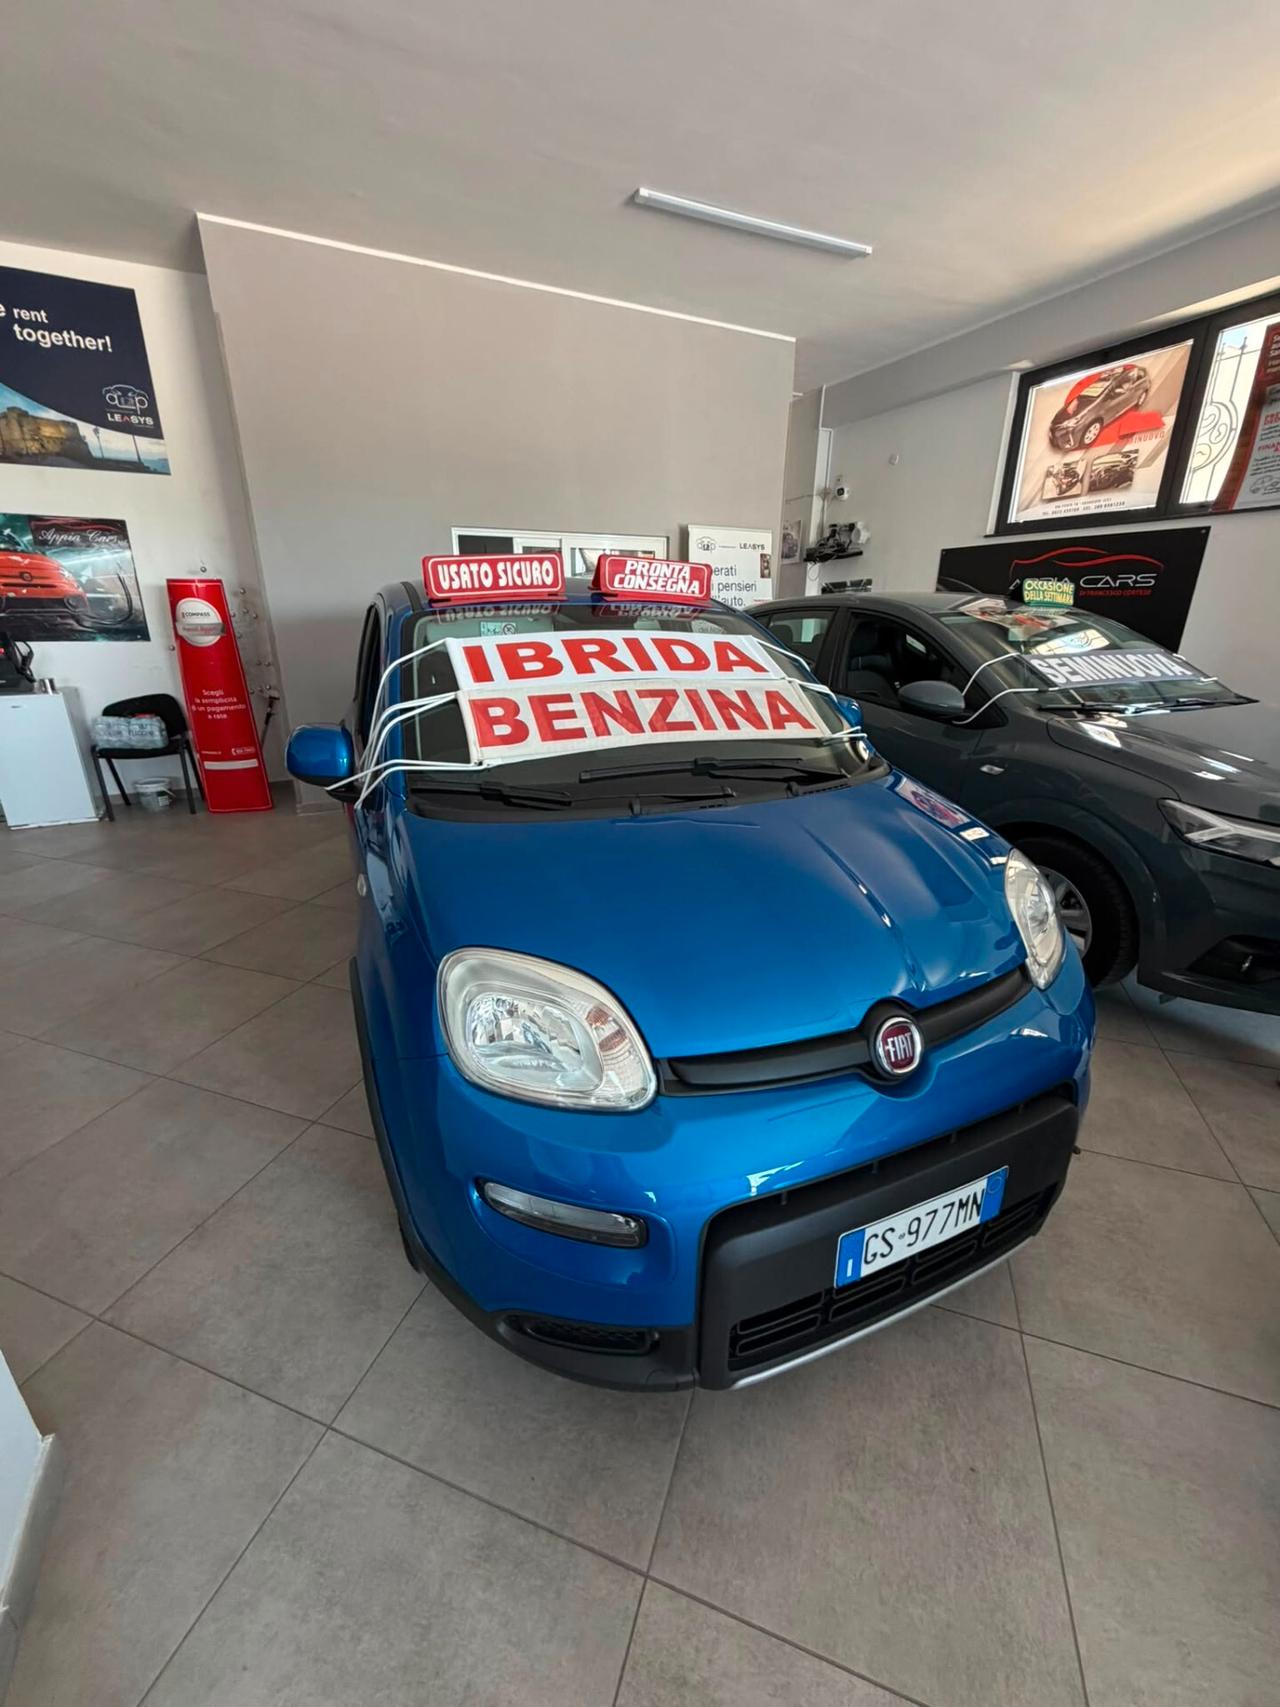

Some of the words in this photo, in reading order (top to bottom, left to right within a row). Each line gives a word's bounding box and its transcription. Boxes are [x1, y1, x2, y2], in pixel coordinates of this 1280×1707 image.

[12, 308, 48, 323] rent
[13, 323, 112, 352] together!
[107, 413, 153, 426] LEASYS
[39, 528, 80, 544] Appia
[739, 542, 765, 551] LEASYS
[437, 562, 491, 591] USATO
[498, 560, 552, 588] SICURO
[625, 560, 690, 580] PRONTA
[713, 565, 737, 577] erati
[613, 574, 700, 595] CONSEGNA
[718, 581, 757, 593] pensieri
[1025, 580, 1073, 595] OCCASIONE
[1080, 573, 1158, 588] CARS
[462, 637, 770, 683] IBRIDA
[1031, 653, 1193, 684] SEMINUOVA
[468, 689, 817, 748] BENZINA
[885, 1032, 912, 1062] FIAT
